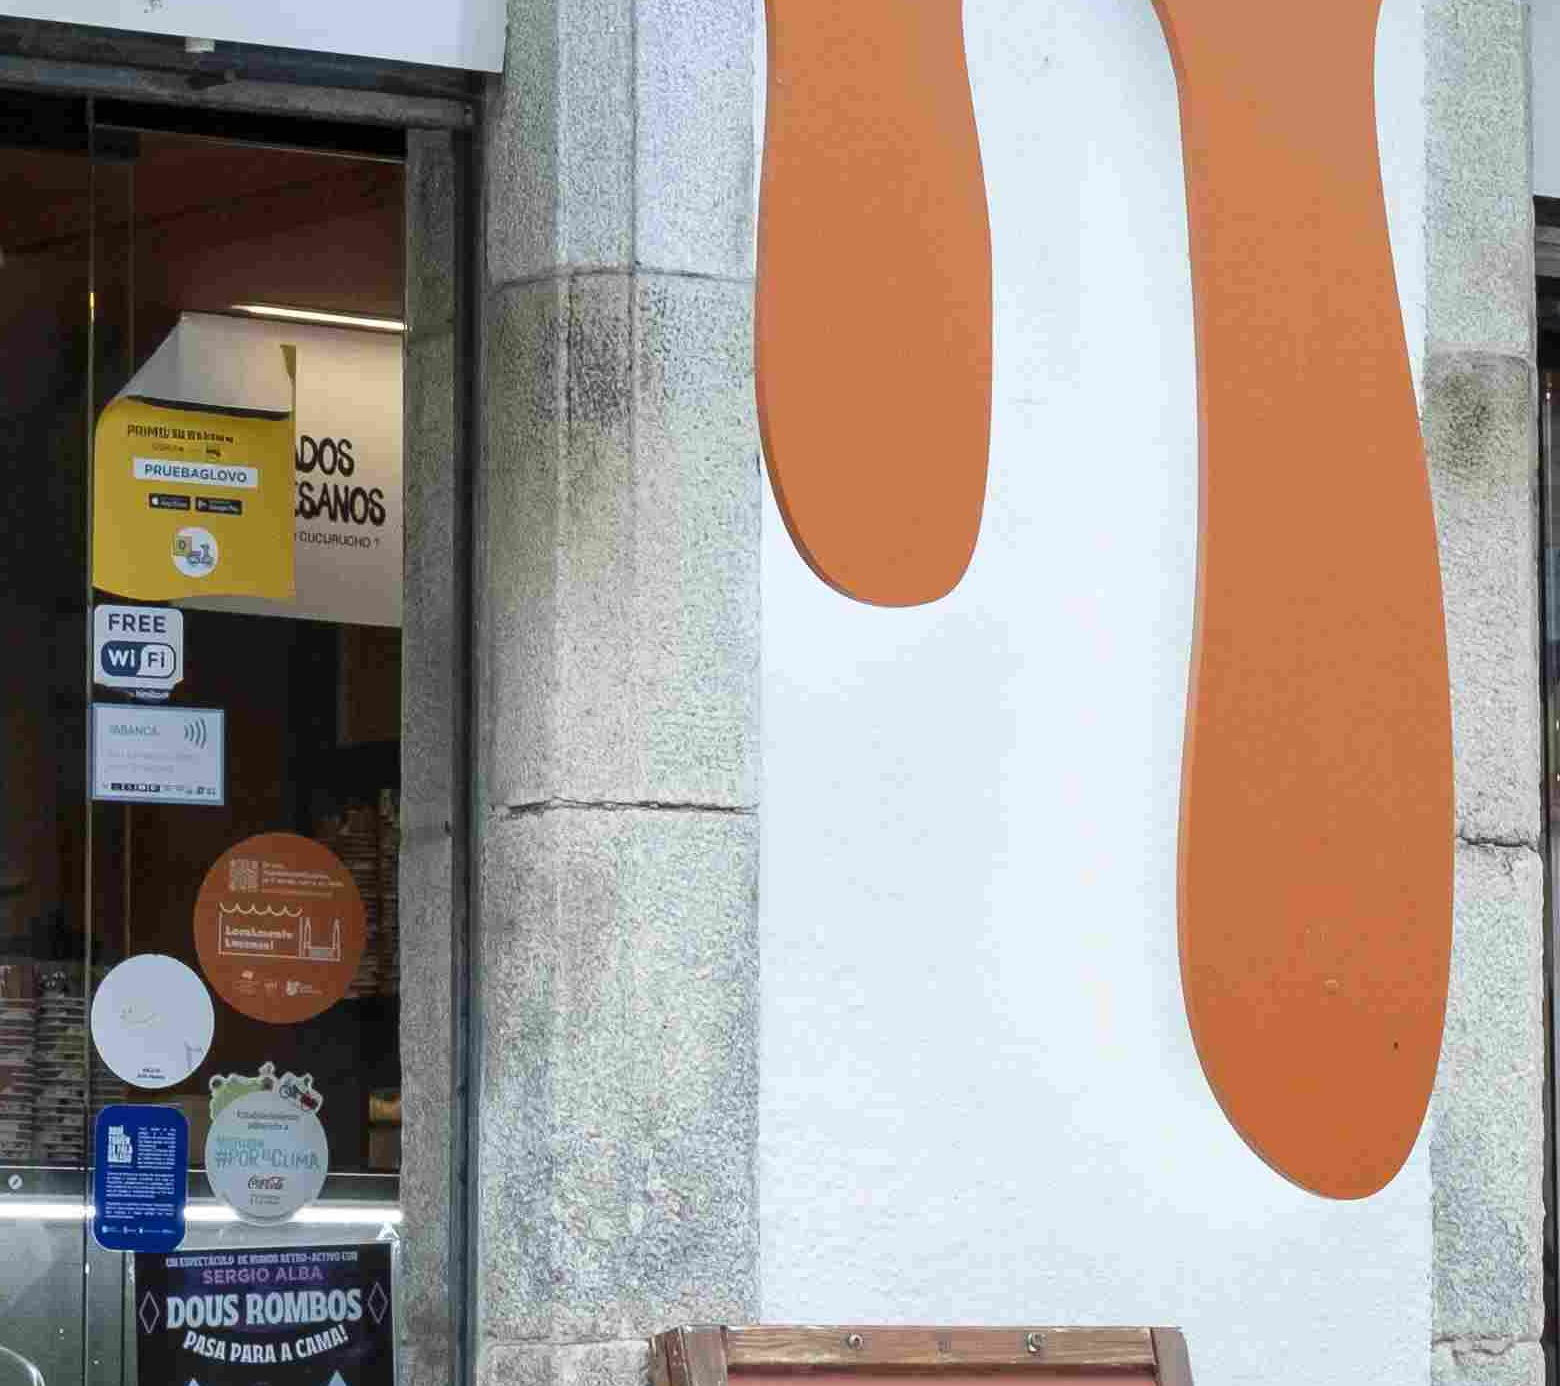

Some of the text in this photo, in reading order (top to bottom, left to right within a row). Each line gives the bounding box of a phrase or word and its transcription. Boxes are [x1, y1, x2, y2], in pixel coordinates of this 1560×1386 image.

[144, 463, 247, 483] PRUEBAGLOVO
[296, 435, 355, 477] DOS
[296, 481, 386, 526] SANOS
[108, 613, 166, 633] FREE
[202, 1265, 323, 1286] SERGIO ALBA
[167, 1288, 362, 1329] DOUS ROMBOS
[182, 1324, 349, 1363] PASA PARA A CAMA!
